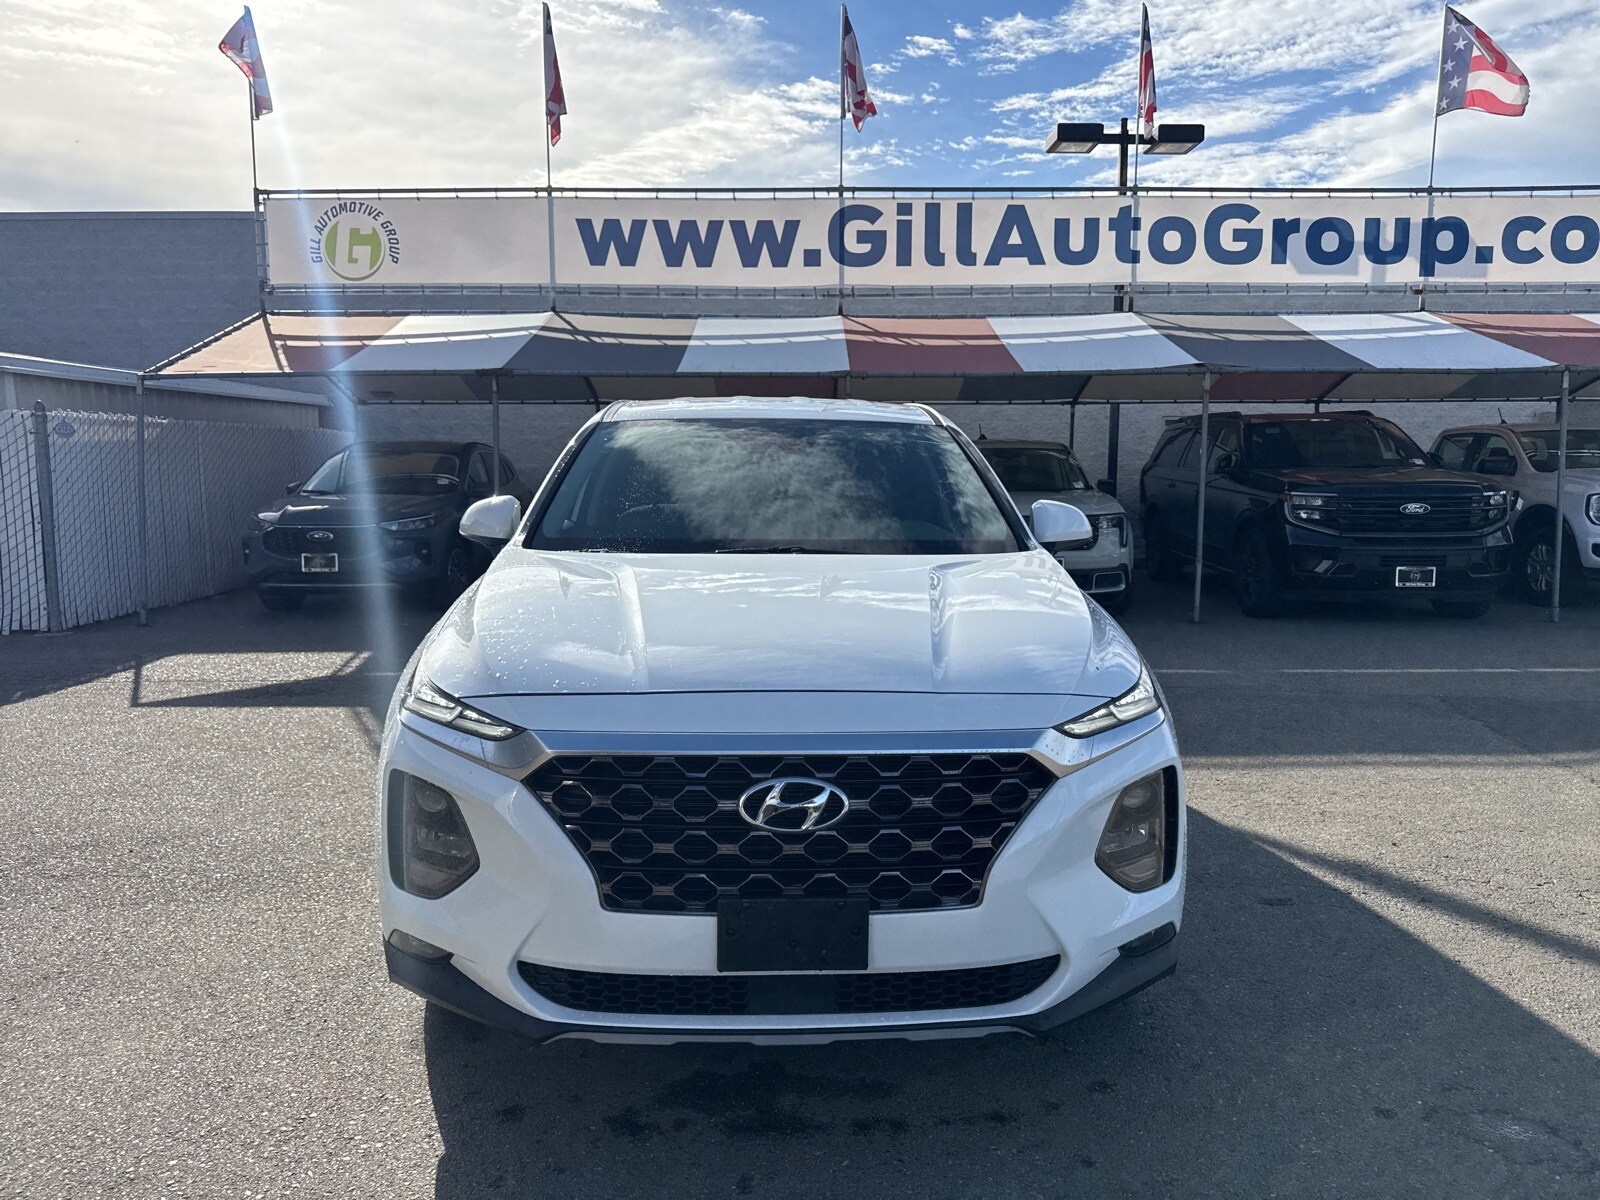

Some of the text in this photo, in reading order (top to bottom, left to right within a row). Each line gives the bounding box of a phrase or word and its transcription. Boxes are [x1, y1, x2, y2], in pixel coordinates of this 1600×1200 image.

[309, 201, 400, 264] GILL AUTOMOTIVE GROUP
[575, 203, 1600, 277] www.GillAutoGroup.co
